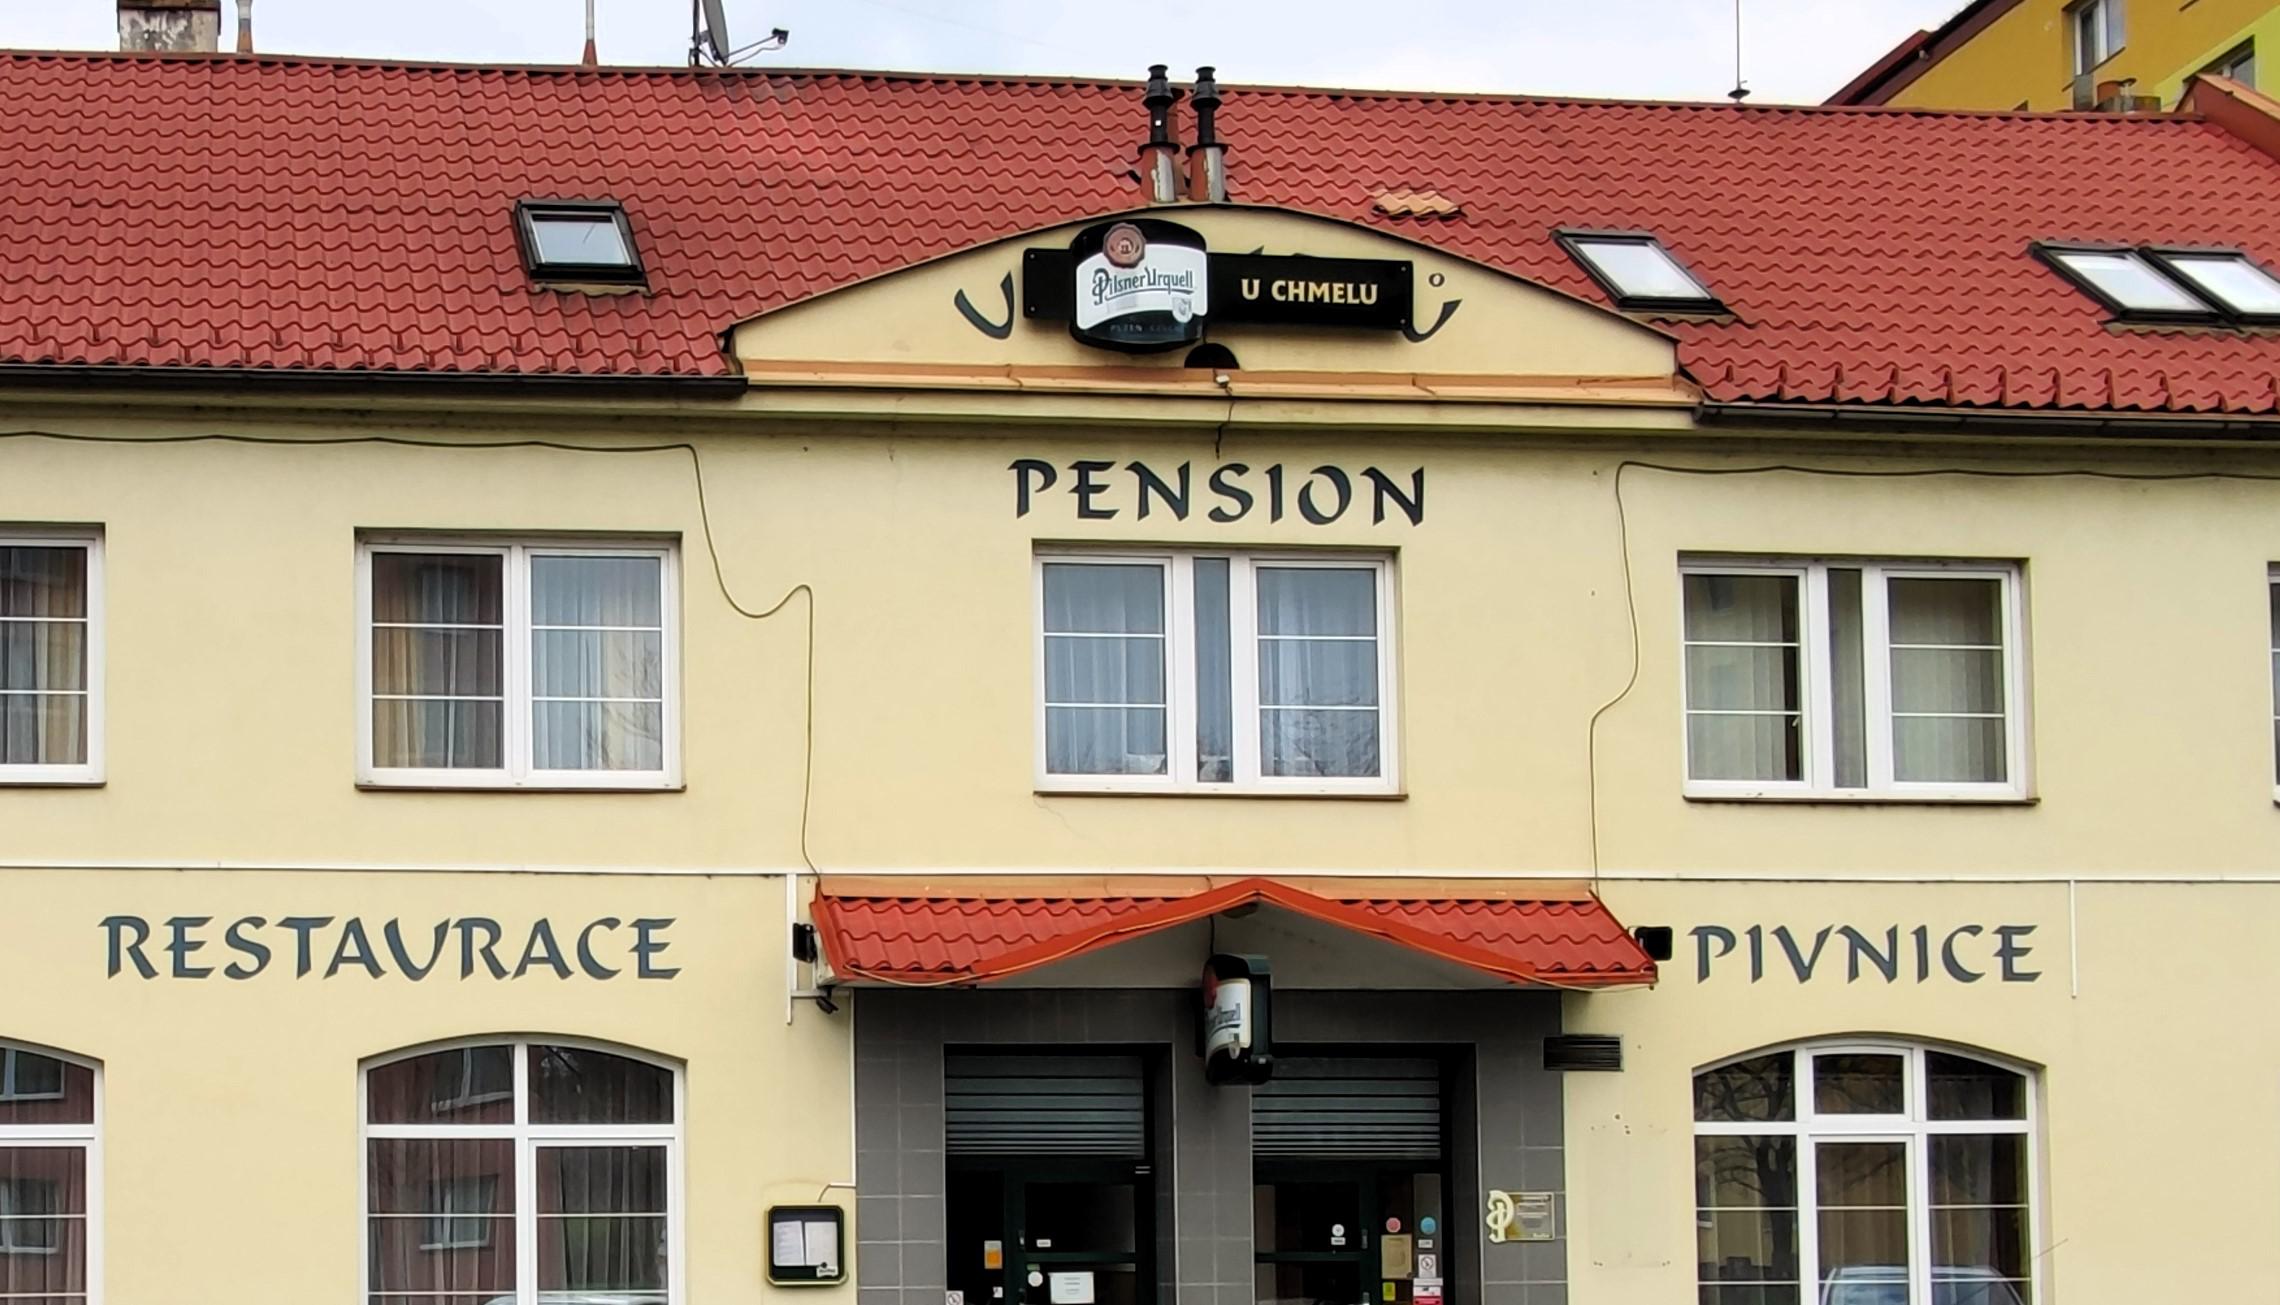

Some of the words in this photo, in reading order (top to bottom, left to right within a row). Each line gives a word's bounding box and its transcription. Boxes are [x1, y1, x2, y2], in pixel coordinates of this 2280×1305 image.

[1092, 267, 1145, 306] Pilsner
[1145, 266, 1193, 295] Urquell
[1241, 278, 1261, 300] U
[1271, 279, 1379, 305] CHMELU
[1008, 458, 1425, 527] PENSION
[97, 915, 682, 981] RESTAURACE
[1688, 924, 2042, 984] PIVNICE
